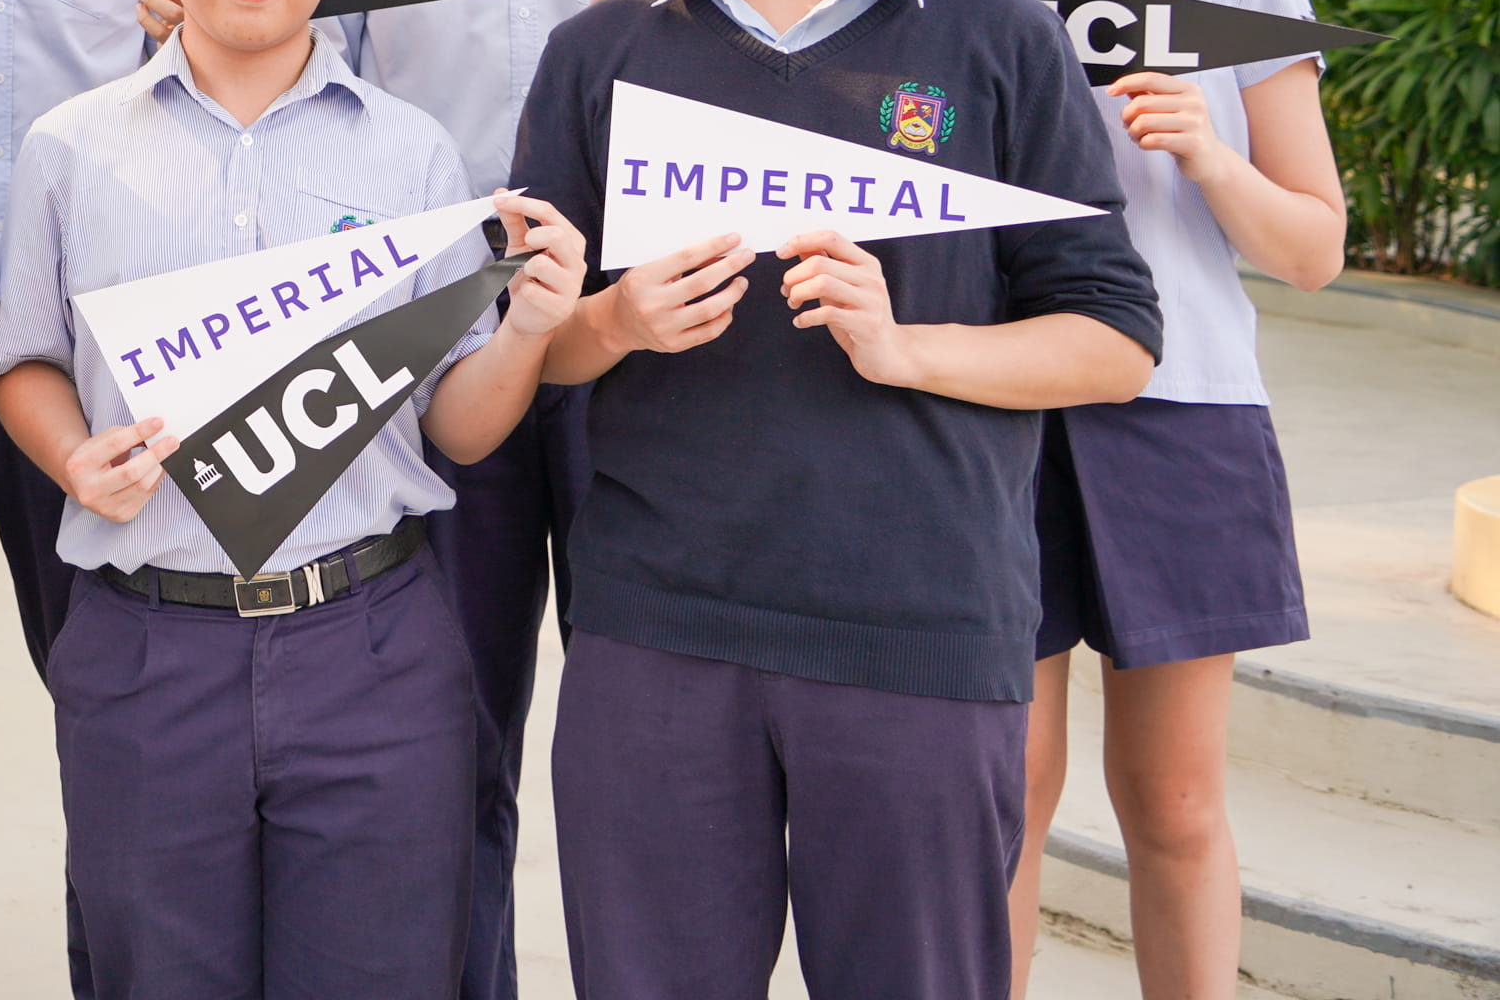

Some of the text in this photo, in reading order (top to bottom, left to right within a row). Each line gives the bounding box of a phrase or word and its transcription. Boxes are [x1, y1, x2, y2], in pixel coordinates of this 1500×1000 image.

[1042, 0, 1200, 68] CL
[621, 158, 966, 222] IMPERIAL
[120, 234, 419, 387] IMPERIAL
[211, 339, 415, 496] UCL
